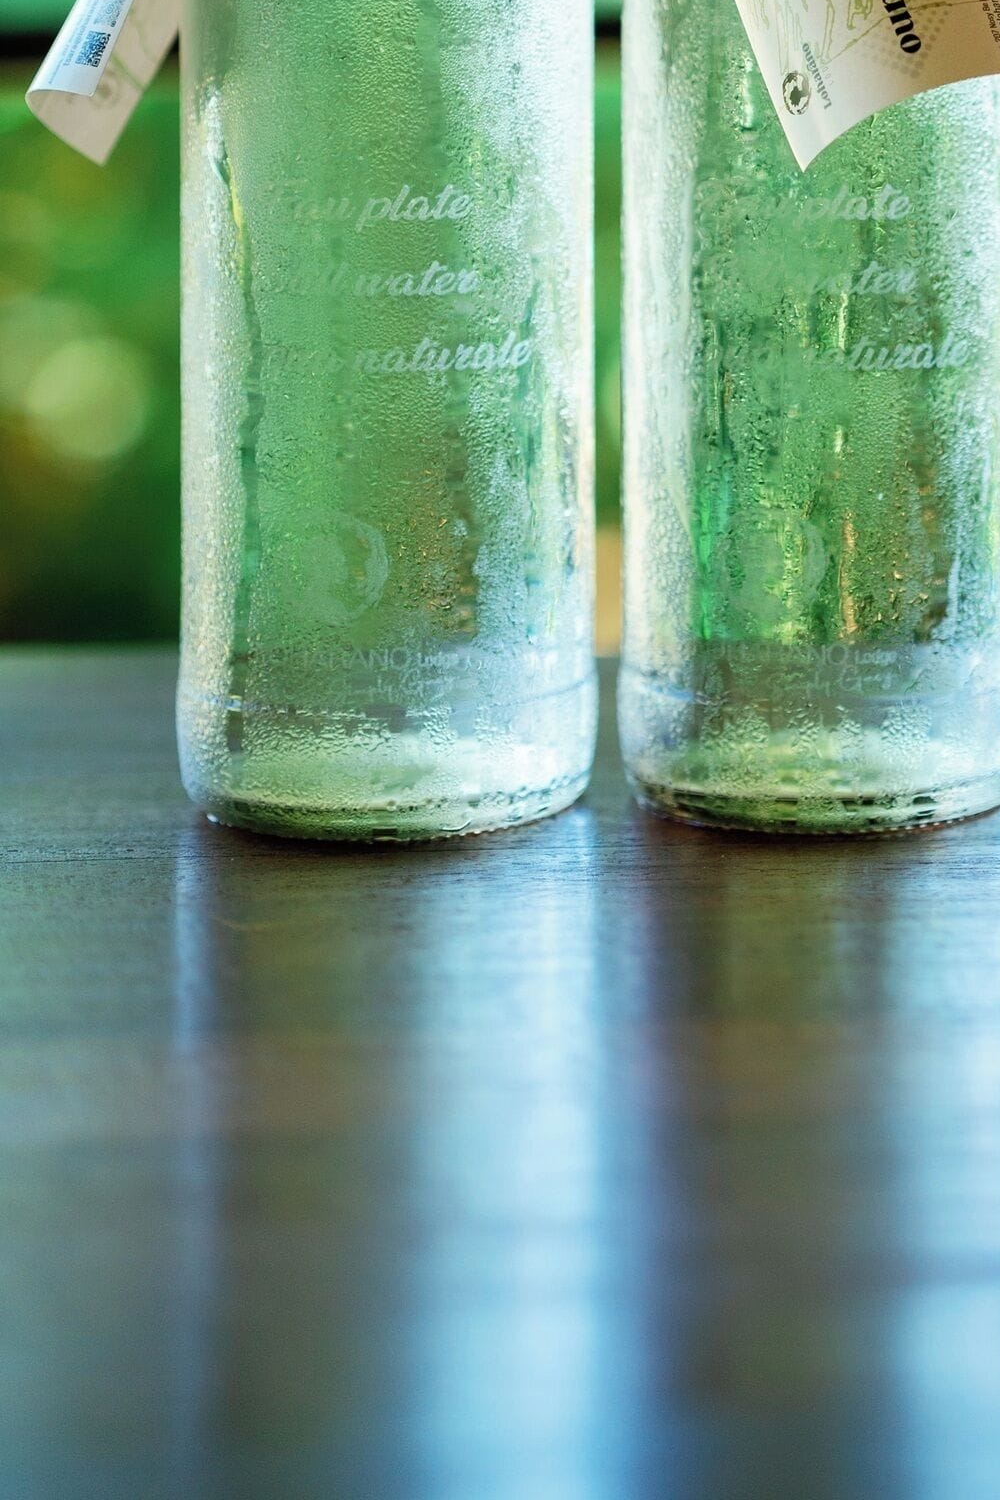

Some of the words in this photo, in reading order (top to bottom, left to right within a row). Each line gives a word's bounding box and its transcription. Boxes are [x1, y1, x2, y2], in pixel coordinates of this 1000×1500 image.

[986, 12, 999, 29] Nosy
[355, 183, 474, 232] plate
[796, 183, 911, 230] plate
[356, 260, 479, 297] water
[353, 330, 533, 374] naturale
